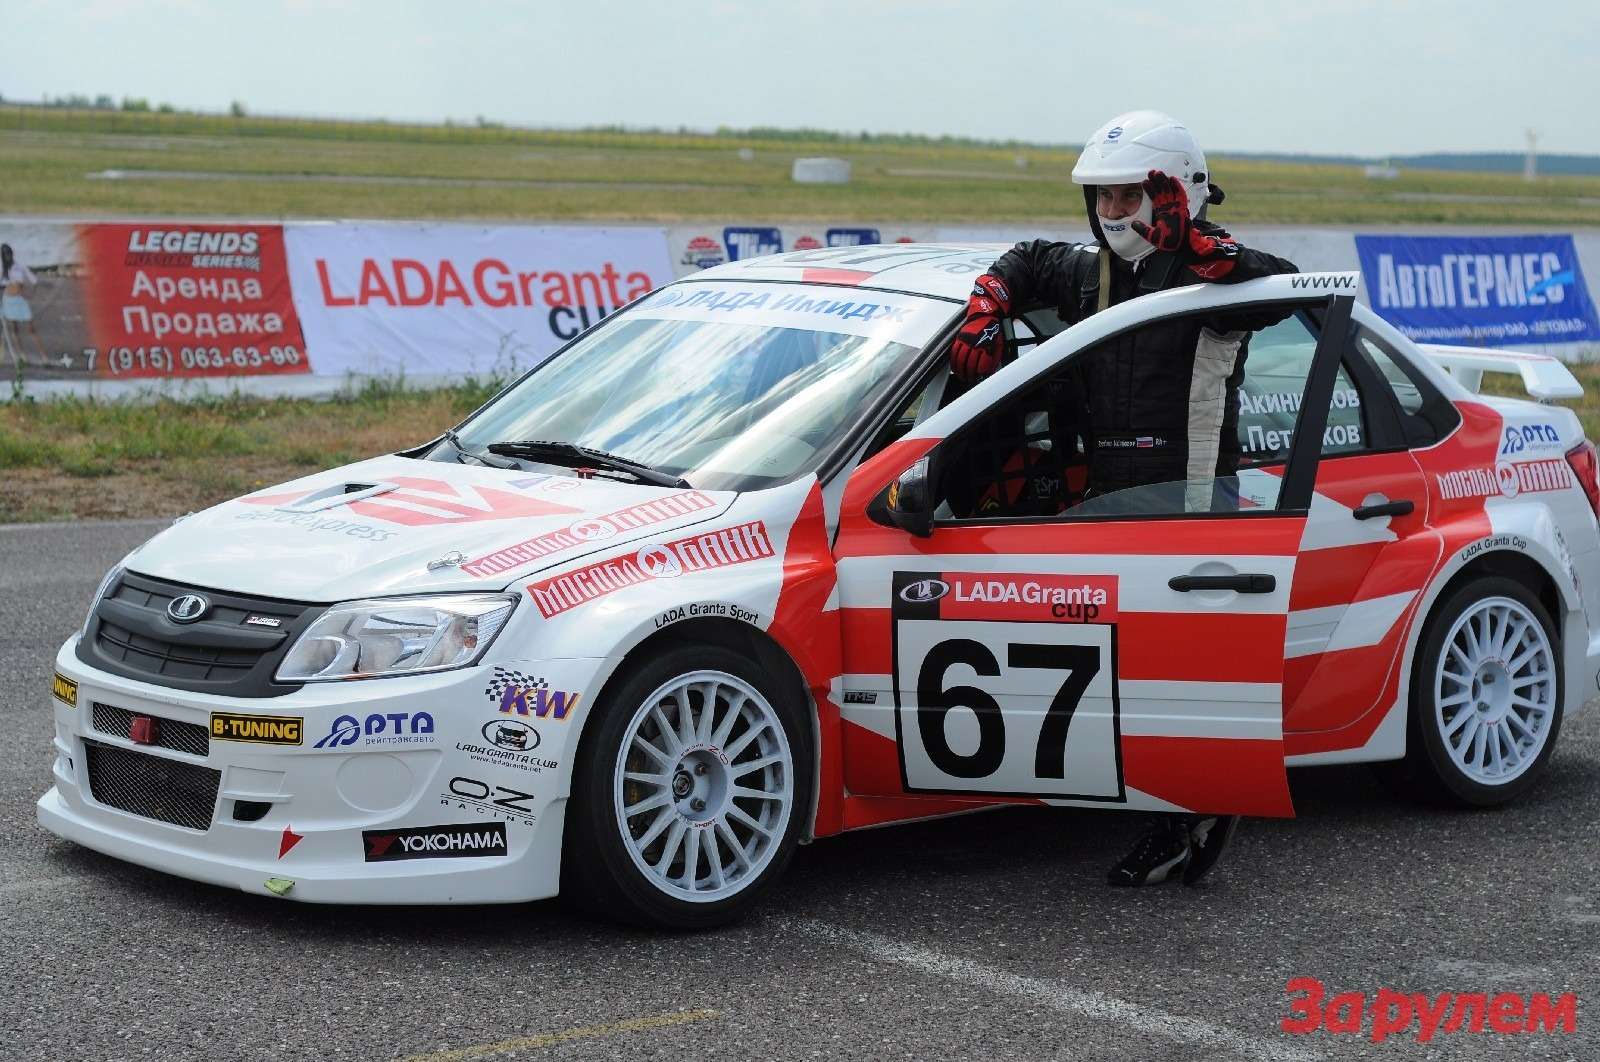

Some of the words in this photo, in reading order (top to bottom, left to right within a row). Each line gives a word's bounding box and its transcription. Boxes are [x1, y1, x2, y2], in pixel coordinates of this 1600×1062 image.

[128, 230, 260, 254] LEGENDS
[191, 254, 243, 268] SERIES
[131, 269, 263, 304] Аренда
[122, 305, 284, 340] Продажа
[549, 304, 624, 341] cu
[83, 349, 97, 370] 7
[108, 348, 174, 374] (915)
[181, 345, 300, 370] 063-63-90
[1461, 543, 1483, 561] LADA
[1484, 536, 1510, 549] Granta
[1512, 537, 1527, 549] Cup
[654, 608, 687, 629] LADA
[689, 603, 726, 616] Granta
[729, 604, 759, 626] Sport
[1051, 602, 1099, 623] cup
[499, 685, 579, 721] KW
[917, 638, 1101, 779] 67
[455, 742, 485, 755] LADA
[487, 748, 530, 765] GRANTA
[530, 757, 559, 769] CLUB
[440, 799, 534, 827] RACING
[399, 831, 505, 852] YOKOHAMA
